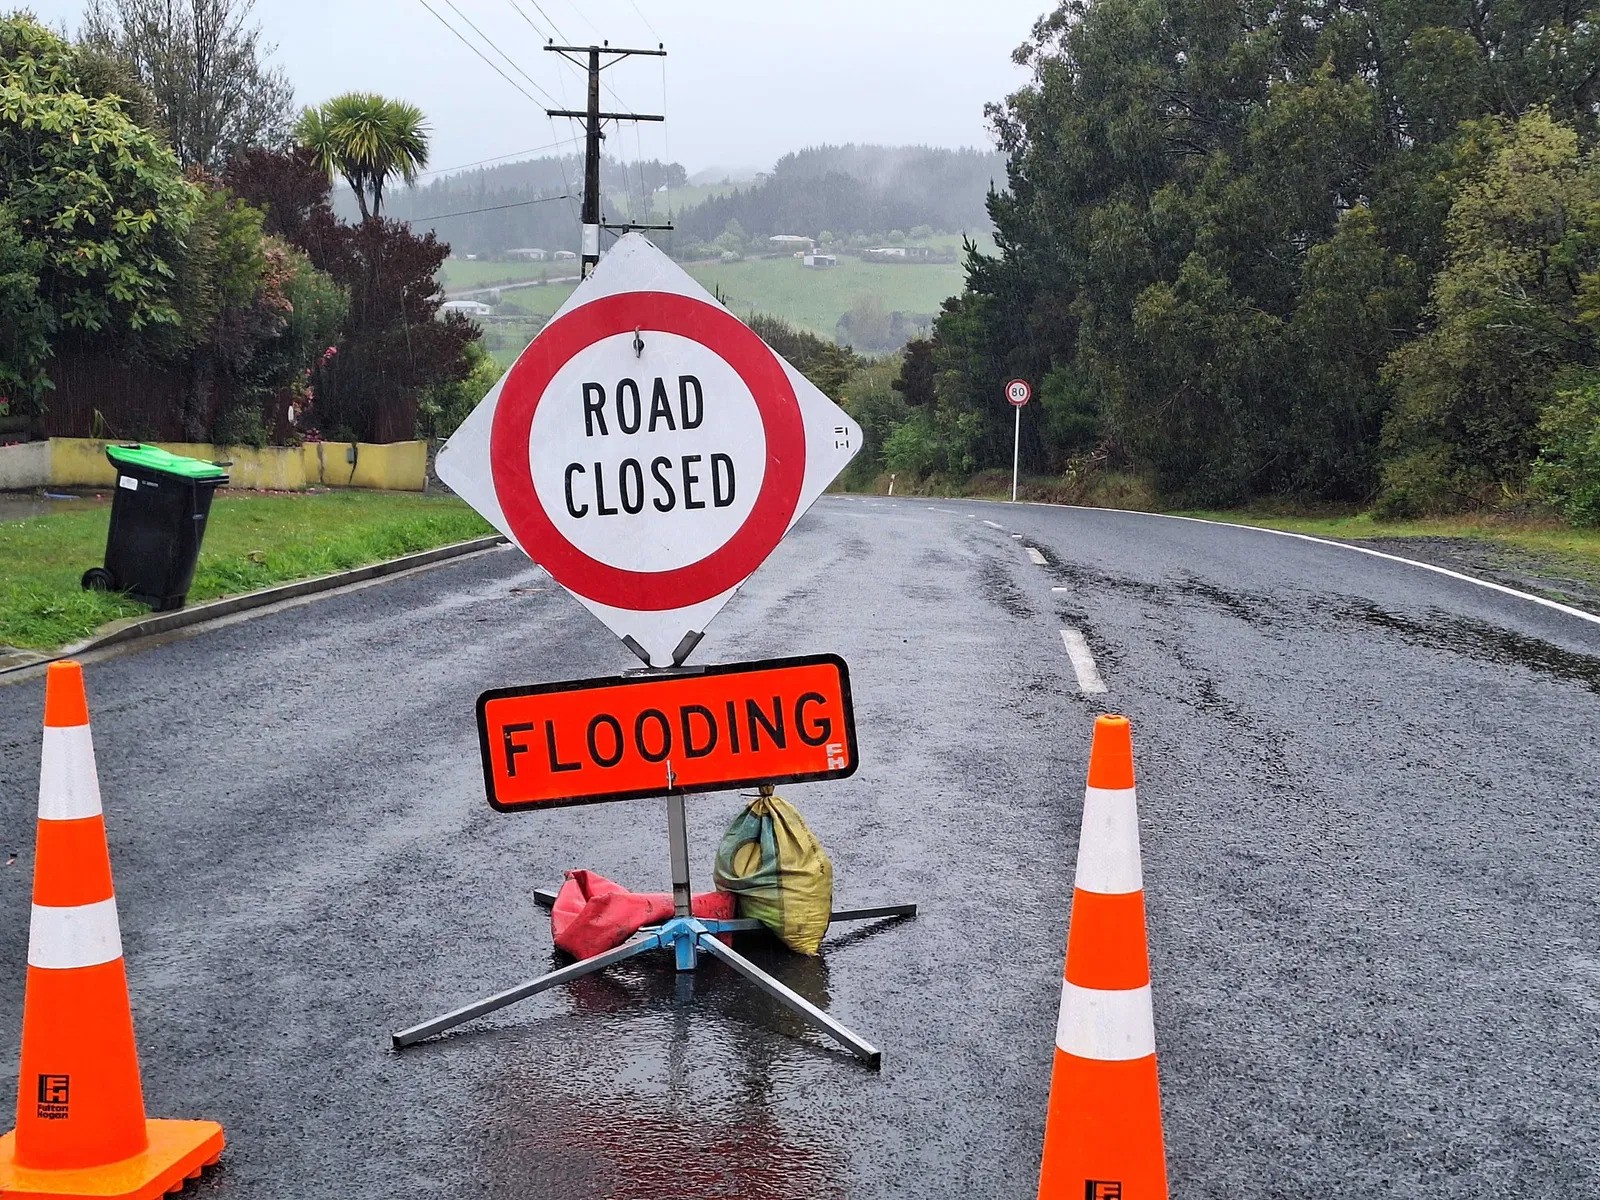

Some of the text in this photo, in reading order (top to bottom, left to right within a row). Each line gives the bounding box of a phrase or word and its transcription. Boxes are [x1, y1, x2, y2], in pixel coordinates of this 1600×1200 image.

[582, 374, 704, 437] ROAD
[1011, 387, 1025, 397] 80
[564, 452, 736, 519] CLOSED
[502, 691, 832, 778] FLOODING
